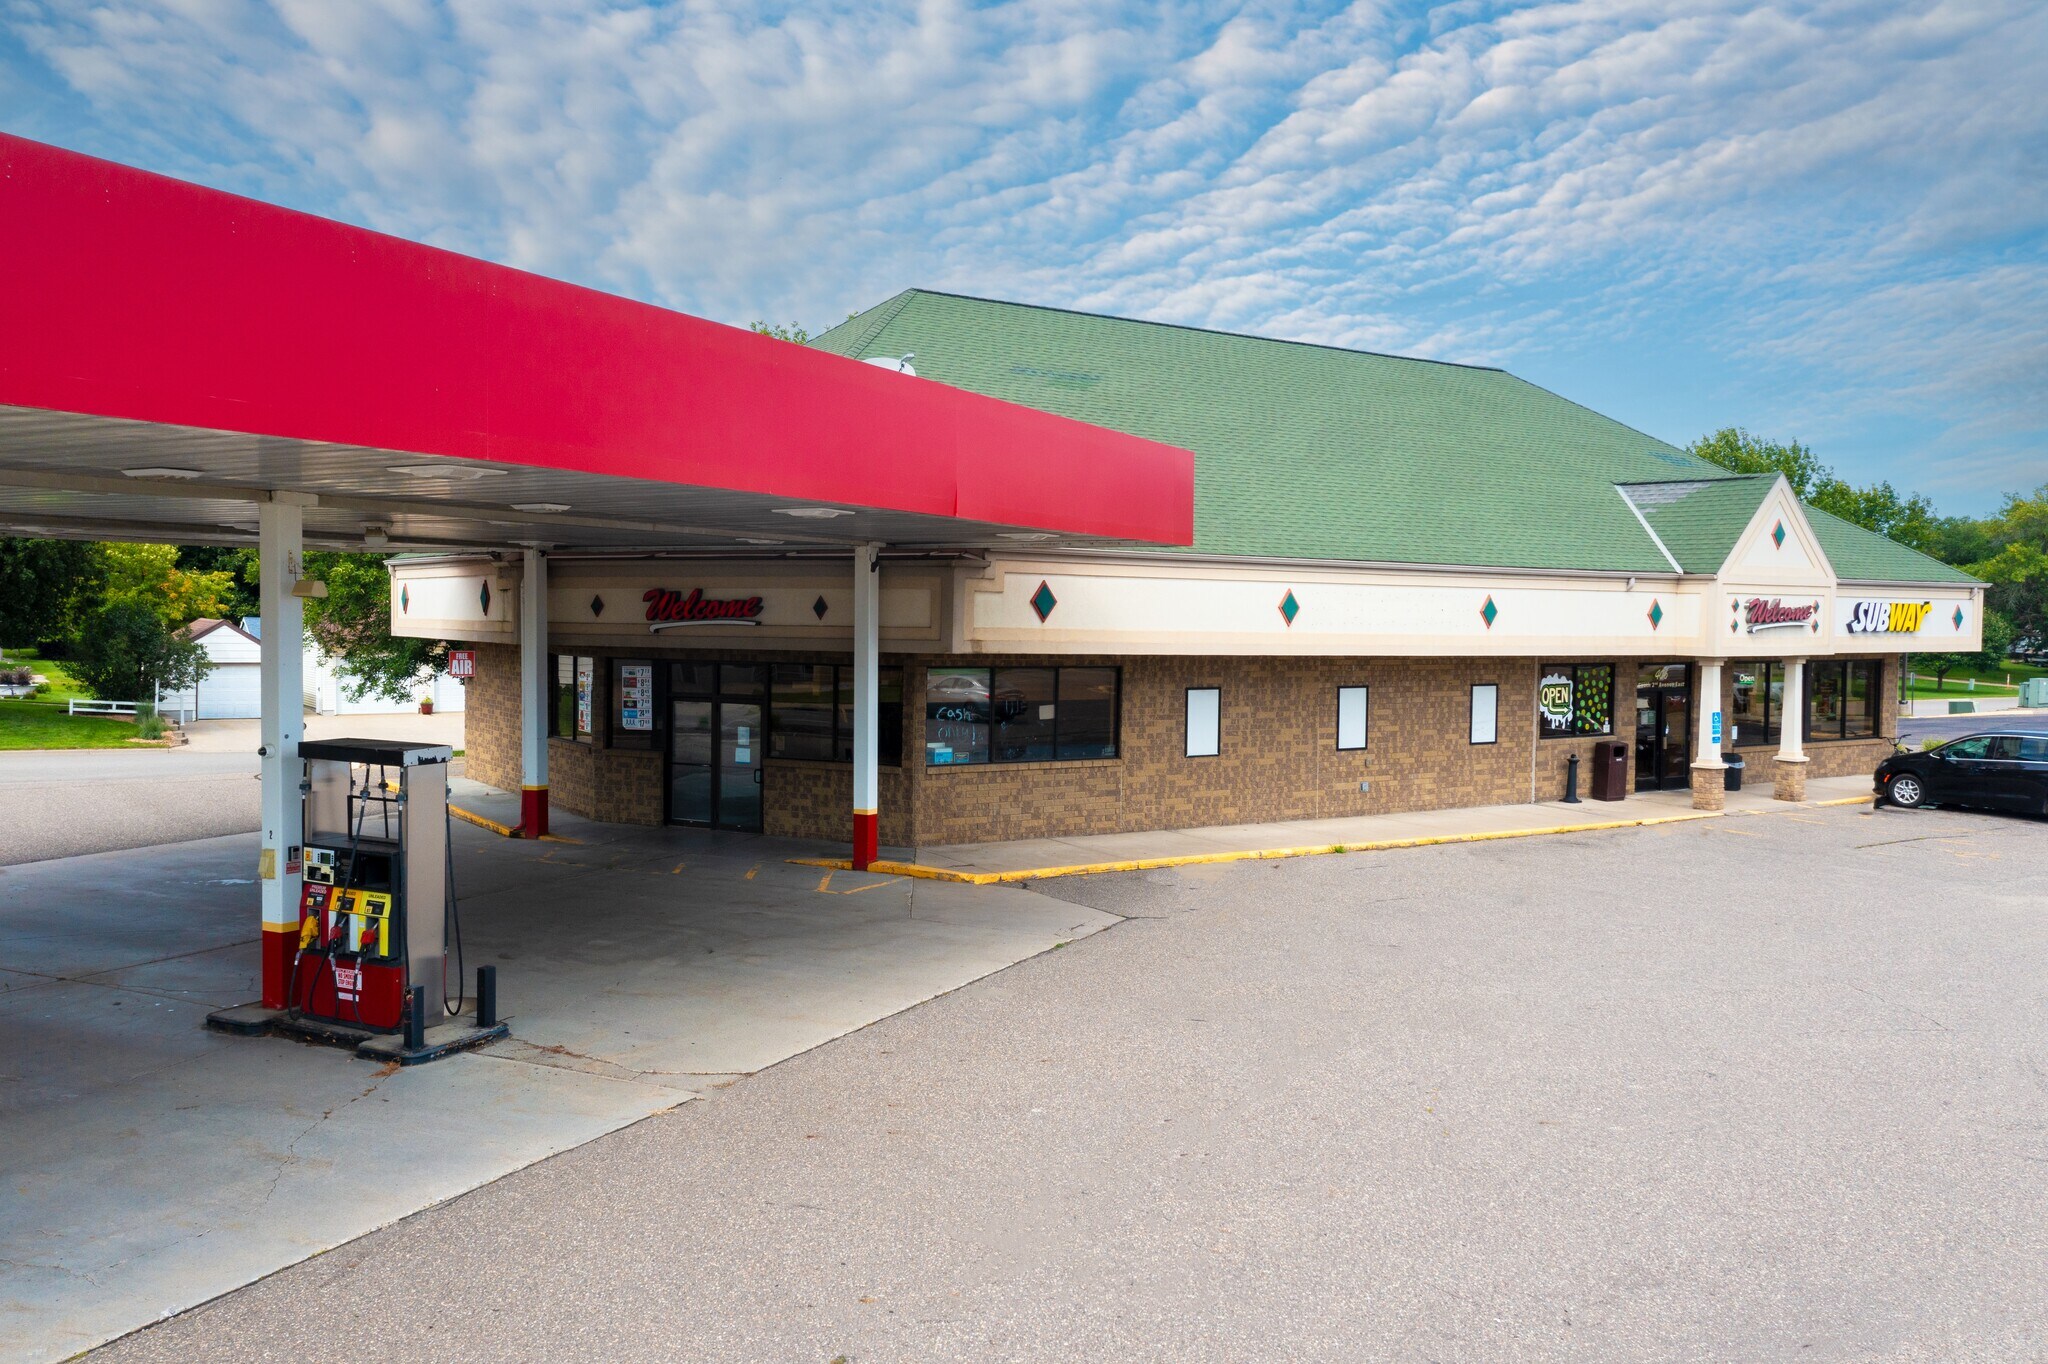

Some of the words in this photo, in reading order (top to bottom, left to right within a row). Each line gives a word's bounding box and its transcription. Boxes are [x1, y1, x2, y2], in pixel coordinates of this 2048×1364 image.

[642, 588, 764, 621] Welcome
[1744, 597, 1813, 624] Welcome
[1846, 601, 1933, 633] SUBWAY
[455, 652, 469, 660] FREE
[451, 659, 473, 675] AIR
[1739, 674, 1755, 683] Open
[936, 706, 973, 721] Cash
[269, 830, 273, 840] 2
